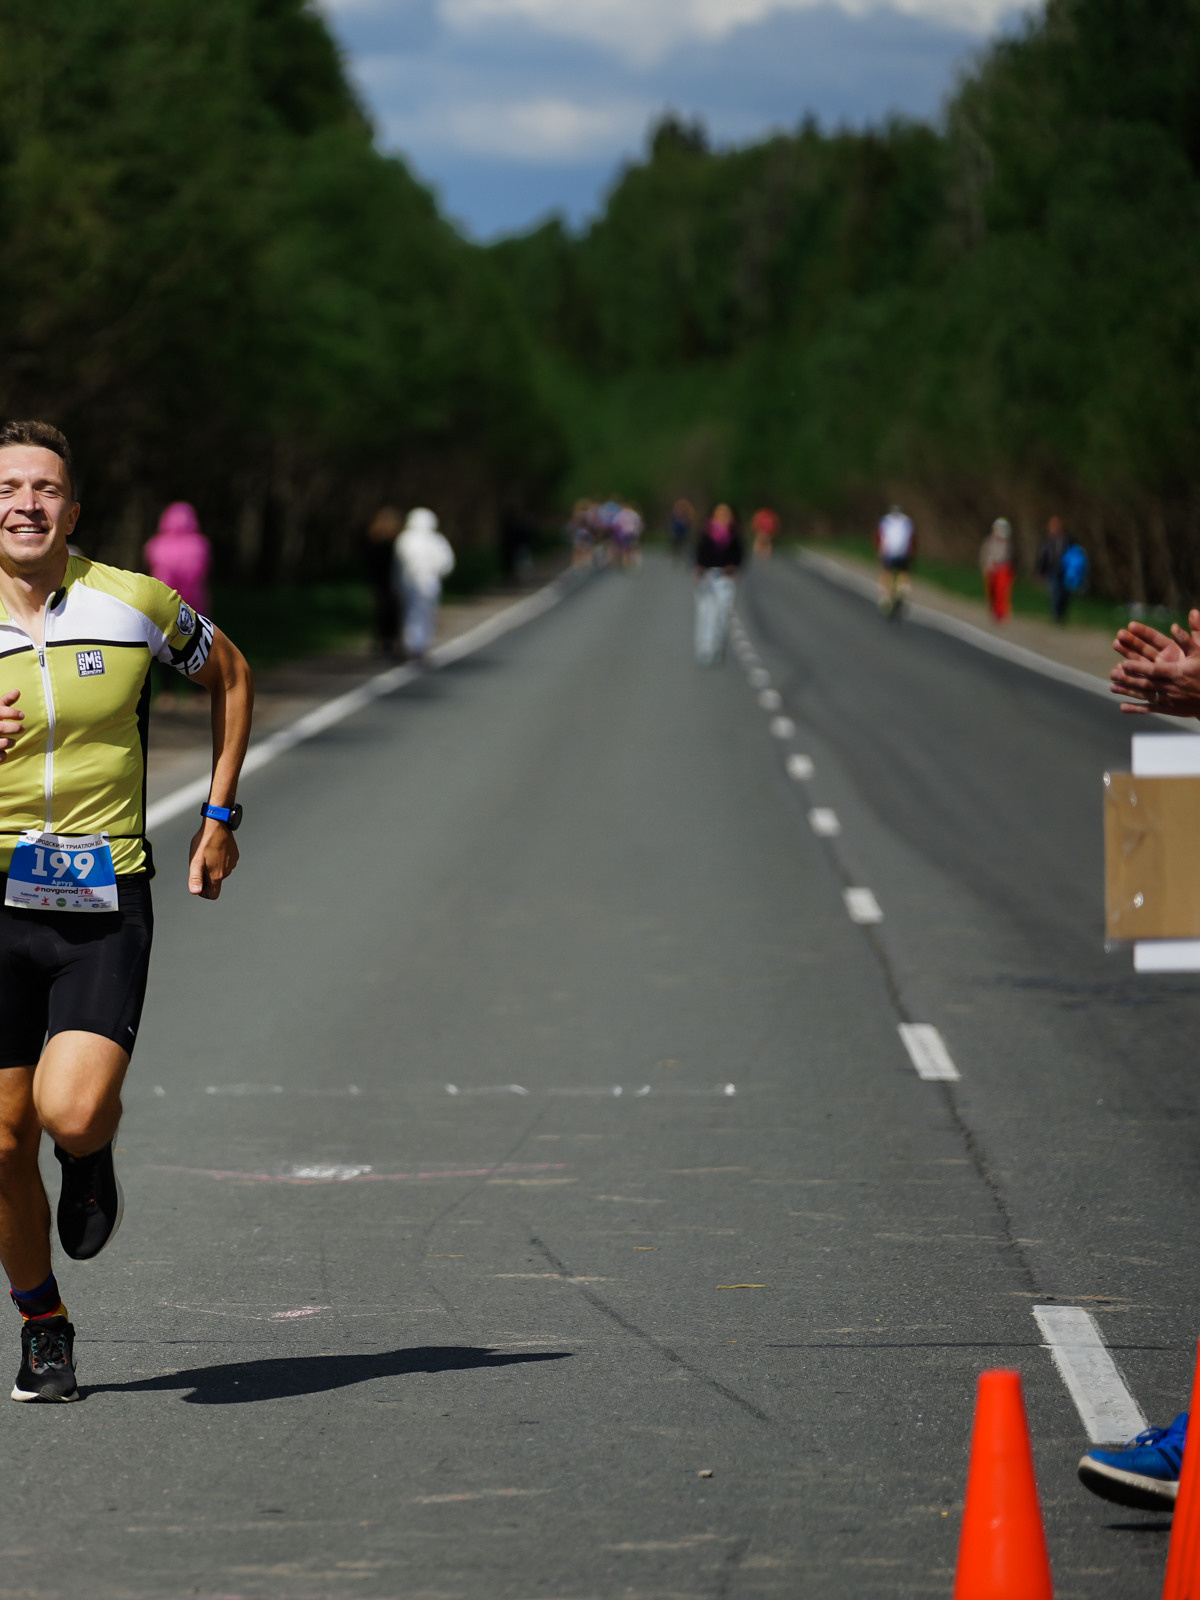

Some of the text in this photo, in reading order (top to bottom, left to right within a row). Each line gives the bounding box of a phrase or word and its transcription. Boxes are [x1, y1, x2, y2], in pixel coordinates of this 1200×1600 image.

[66, 841, 95, 850] ТРИАТЛОН
[31, 848, 95, 880] 199
[51, 879, 74, 887] Артур
